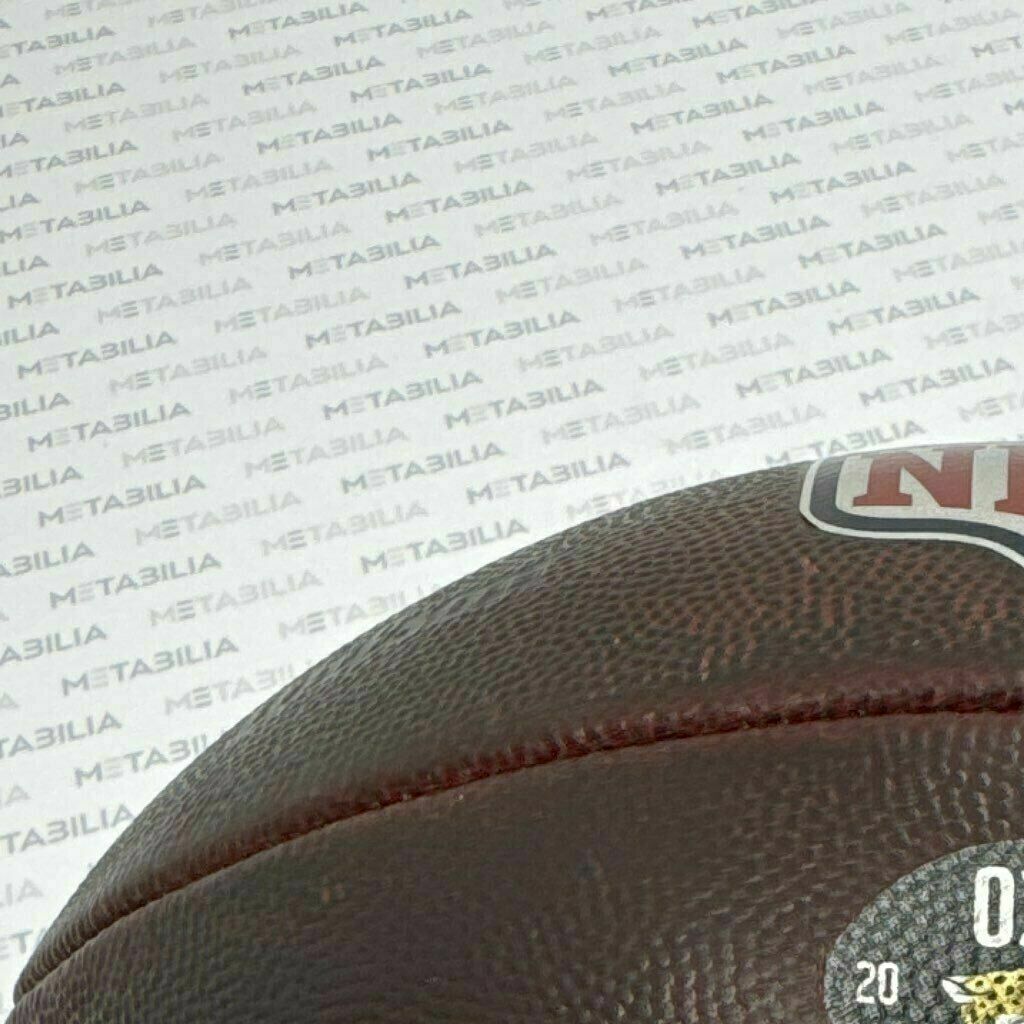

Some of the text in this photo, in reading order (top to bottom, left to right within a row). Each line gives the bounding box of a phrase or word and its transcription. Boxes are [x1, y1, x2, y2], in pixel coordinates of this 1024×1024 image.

[228, 2, 369, 41] METABILIA
[333, 9, 473, 48] METABILIA
[242, 56, 386, 96] METABILIA
[607, 38, 748, 77] METABILIA
[715, 44, 856, 85] METABILIA
[350, 63, 493, 104] METABILIA
[257, 113, 403, 155] METABILIA
[630, 93, 775, 135] METABILIA
[742, 100, 886, 142] METABILIA
[366, 120, 513, 162] METABILIA
[271, 172, 422, 216] METABILIA
[654, 152, 802, 197] METABILIA
[769, 161, 916, 205] METABILIA
[384, 180, 534, 224] METABILIA
[288, 234, 441, 280] METABILIA
[679, 215, 831, 260] METABILIA
[797, 224, 947, 269] METABILIA
[8, 263, 164, 310] METABILIA
[403, 244, 558, 290] METABILIA
[305, 300, 462, 350] METABILIA
[706, 279, 861, 329] METABILIA
[827, 288, 981, 336] METABILIA
[17, 331, 178, 380] METABILIA
[423, 310, 581, 359] METABILIA
[321, 370, 483, 420] METABILIA
[735, 348, 893, 399] METABILIA
[858, 357, 1016, 408] METABILIA
[27, 402, 192, 453] METABILIA
[443, 379, 606, 430] METABILIA
[340, 442, 508, 495] METABILIA
[465, 450, 630, 506] METABILIA
[38, 475, 207, 529] METABILIA
[360, 518, 528, 575] METABILIA
[50, 553, 222, 610] METABILIA
[61, 636, 240, 697] METABILIA
[855, 961, 899, 1005] 20
